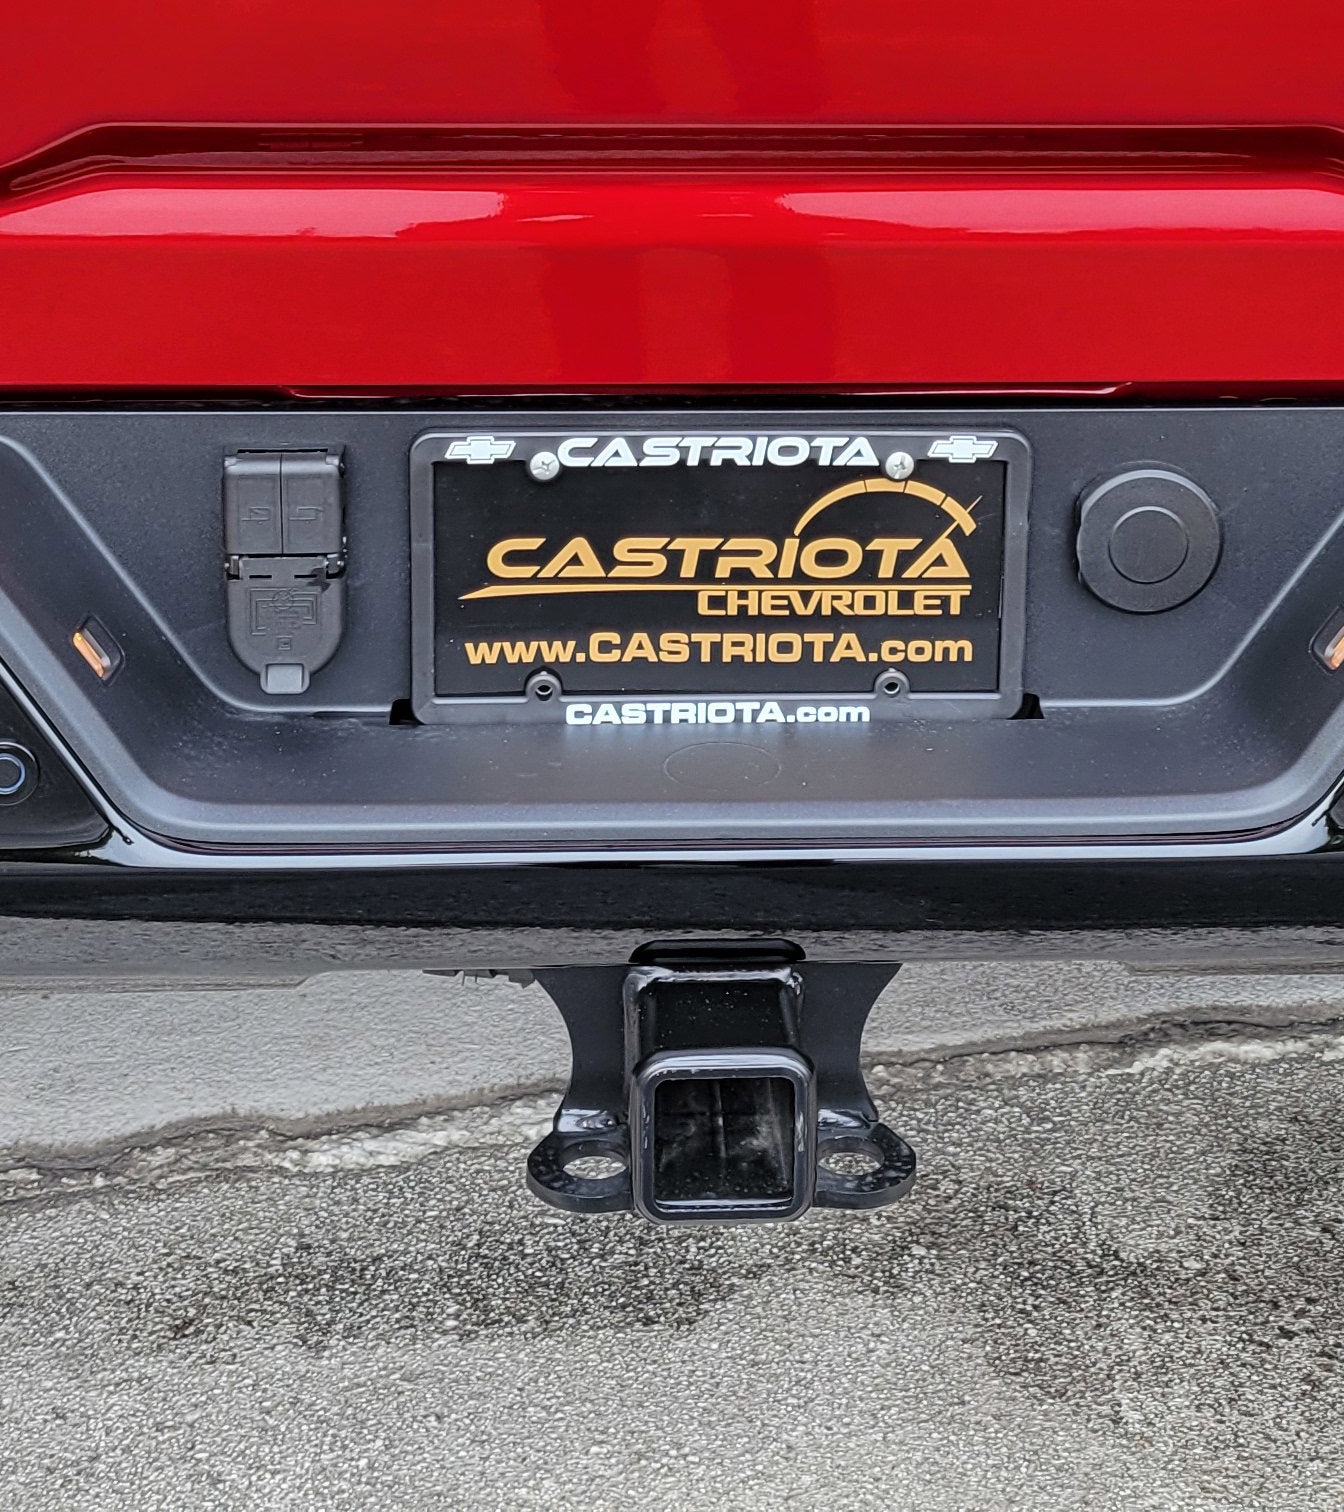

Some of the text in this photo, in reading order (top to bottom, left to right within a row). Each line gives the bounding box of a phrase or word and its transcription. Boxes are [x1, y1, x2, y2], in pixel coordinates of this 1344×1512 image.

[557, 436, 880, 467] CASTRIOTA
[485, 536, 971, 579] CASTRIOTA
[697, 589, 971, 616] CHEVROLET
[464, 631, 973, 665] www.CASTRIOTA.com
[565, 700, 871, 726] CASTRIOTA.com
